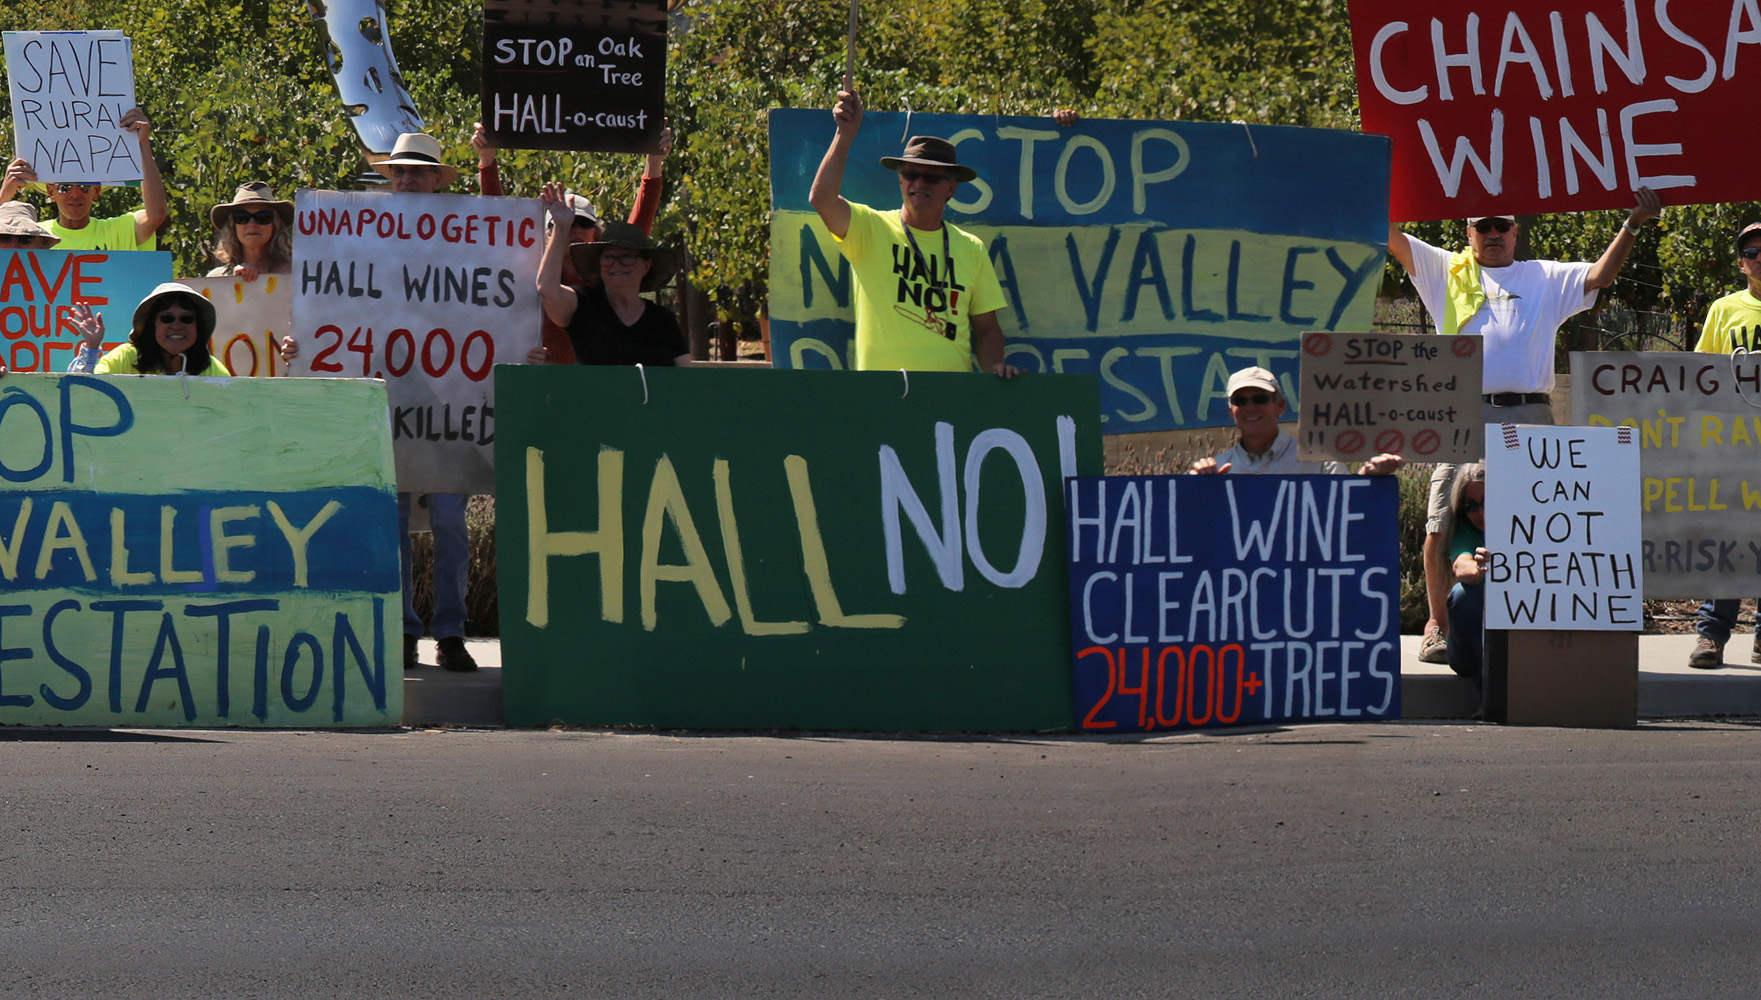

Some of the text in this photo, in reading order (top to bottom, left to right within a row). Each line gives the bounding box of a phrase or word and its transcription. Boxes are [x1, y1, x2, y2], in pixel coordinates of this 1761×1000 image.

[17, 38, 127, 97] SAVE
[494, 36, 644, 68] STOP an Oak
[598, 64, 643, 86] Tree
[493, 92, 648, 134] HALL-o-caust
[32, 134, 140, 174] NAPA
[1417, 98, 1697, 199] WINE
[946, 127, 1190, 219] STOP
[298, 208, 536, 249] UNAPOLOGETIC
[301, 260, 515, 308] HALL WINES
[892, 243, 965, 292] HALL
[1065, 225, 1381, 333] VALLEY
[897, 278, 959, 316] NO!
[1344, 339, 1438, 360] STOP the
[1313, 371, 1457, 393] Watershed
[1591, 365, 1720, 395] CRAIG
[393, 402, 495, 446] KILLED
[1313, 402, 1457, 426] HALL-o-caust
[1528, 436, 1588, 470] WE
[1531, 479, 1591, 504] CAN
[526, 444, 907, 635] HALL
[1071, 479, 1371, 565] HALL WINE
[1510, 510, 1605, 546] NOT
[1490, 551, 1637, 591] BREATH
[1083, 566, 1389, 645] CLEARCUTS
[1503, 587, 1637, 625] WINE
[1250, 641, 1394, 719] TREES
